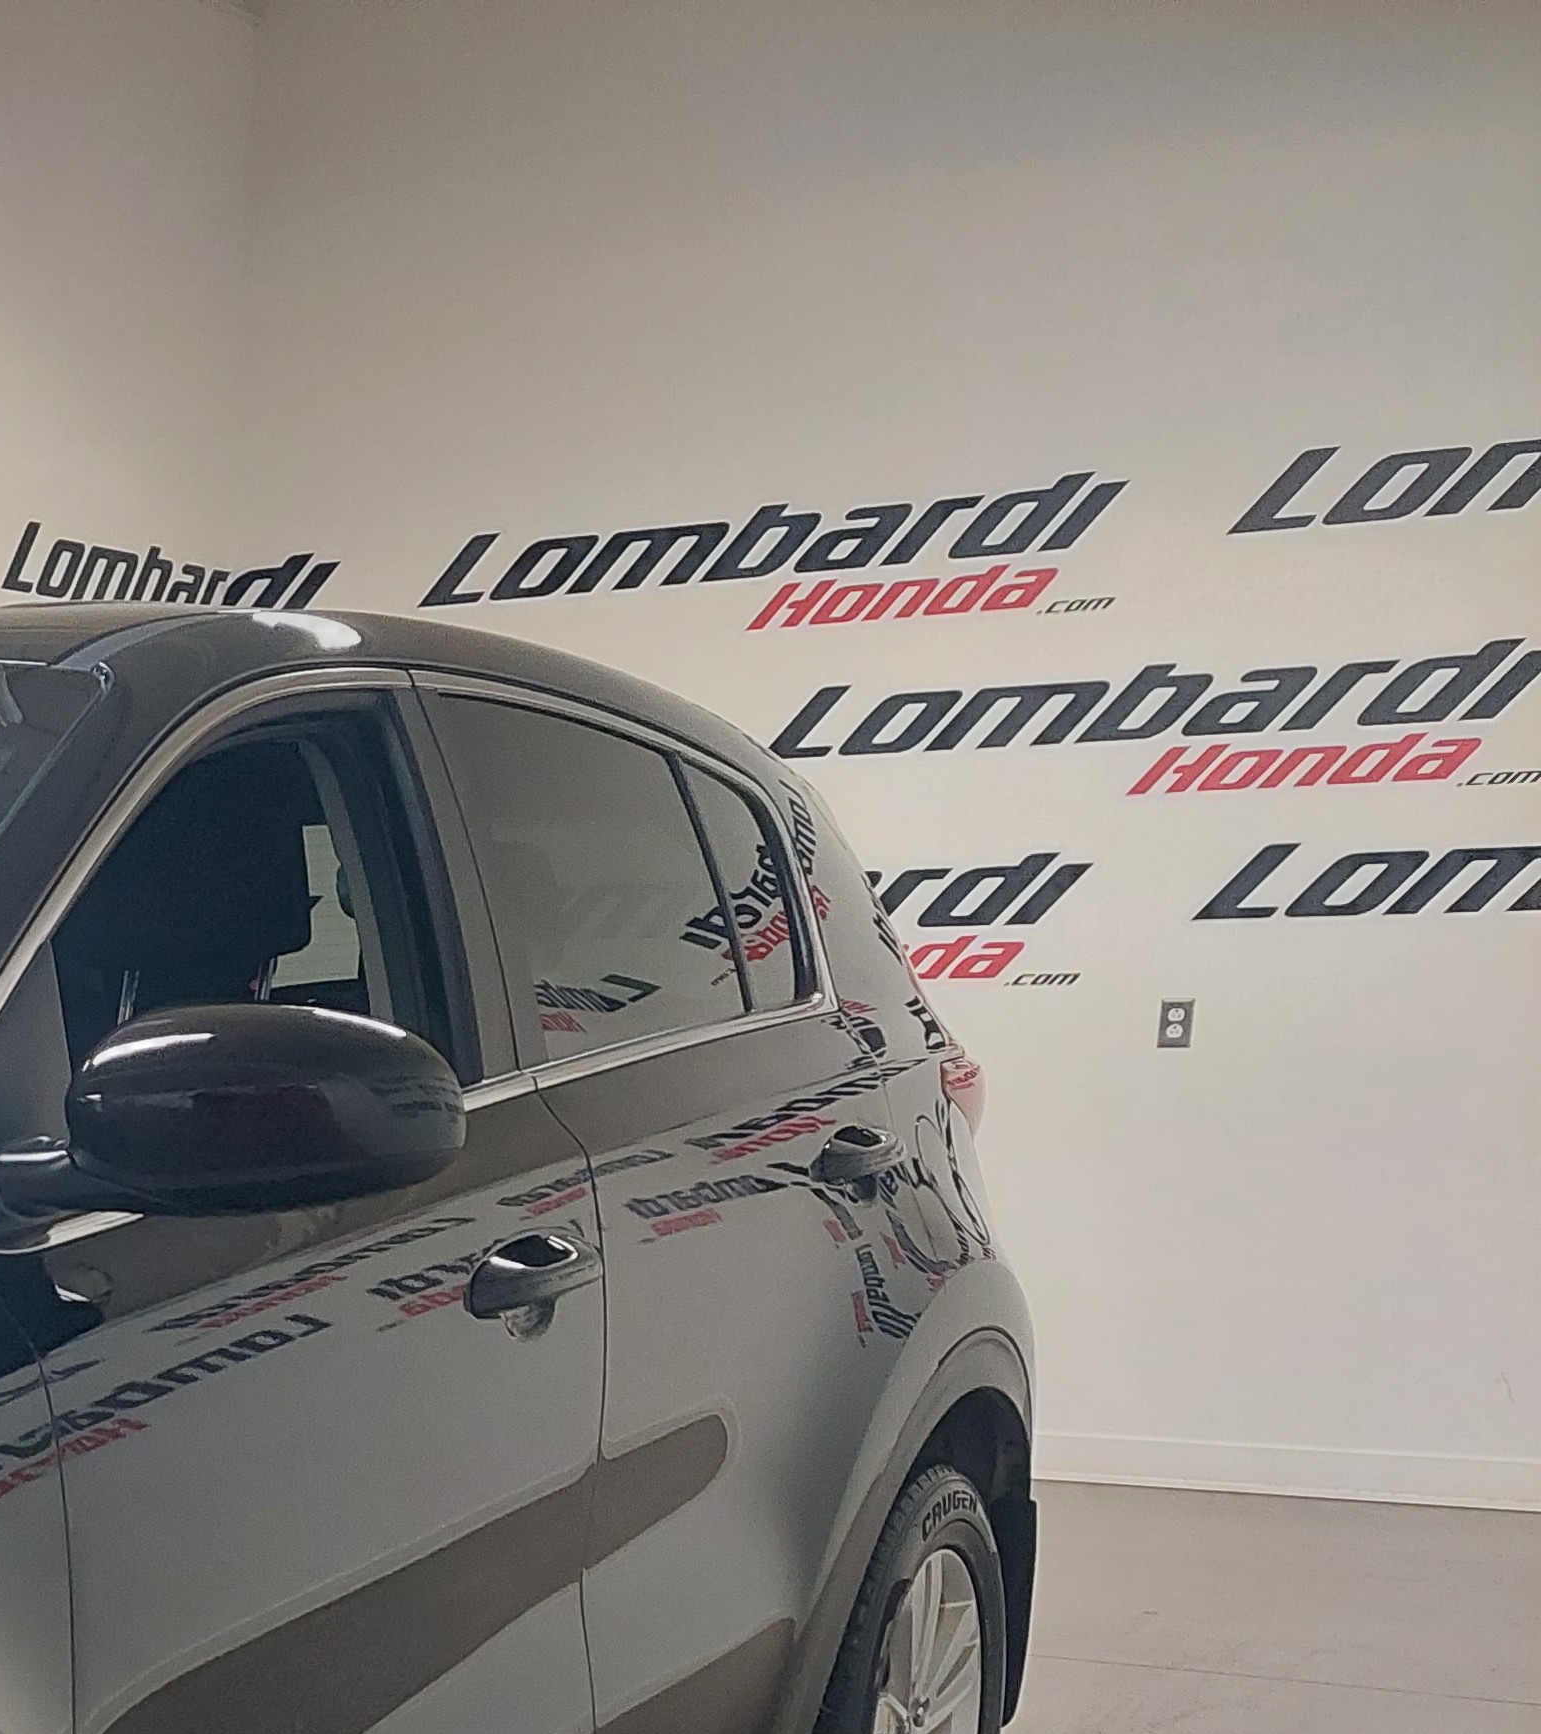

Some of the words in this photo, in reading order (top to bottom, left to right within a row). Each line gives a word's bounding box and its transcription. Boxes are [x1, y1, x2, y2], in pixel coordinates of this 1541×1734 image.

[0, 520, 342, 610] Lombardi
[417, 470, 1130, 609] Lombardi
[745, 563, 1059, 631] Honda
[767, 637, 1541, 760] Lombardi
[1125, 732, 1483, 796] Honda
[863, 852, 1094, 928] rdi
[903, 935, 1025, 980] da
[922, 1489, 977, 1542] CRUGEN
